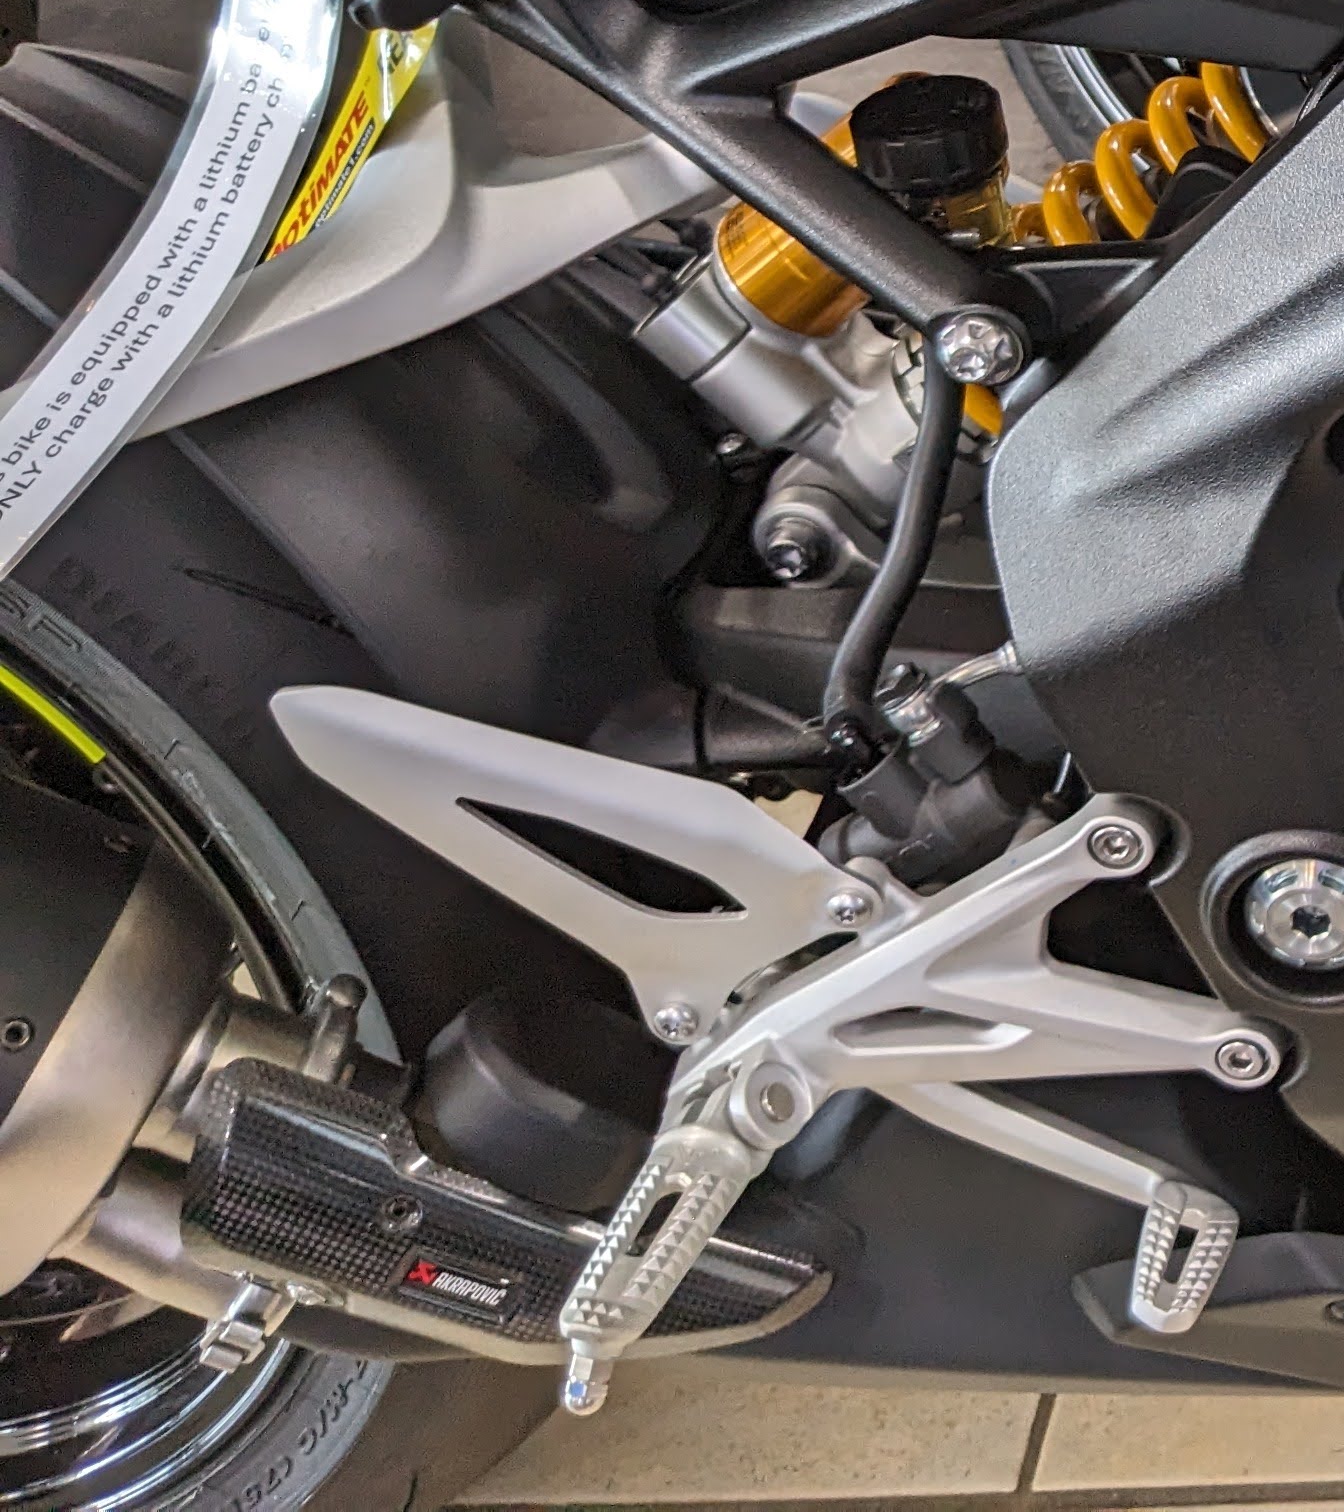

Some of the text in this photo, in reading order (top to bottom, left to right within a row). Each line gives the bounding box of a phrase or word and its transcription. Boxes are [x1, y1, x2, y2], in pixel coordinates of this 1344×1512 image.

[2, 99, 250, 466] bike is equipped with a lithium
[45, 377, 114, 458] charge
[111, 323, 159, 372] with
[157, 304, 175, 318] a
[168, 211, 230, 297] lithium
[220, 112, 274, 206] battery
